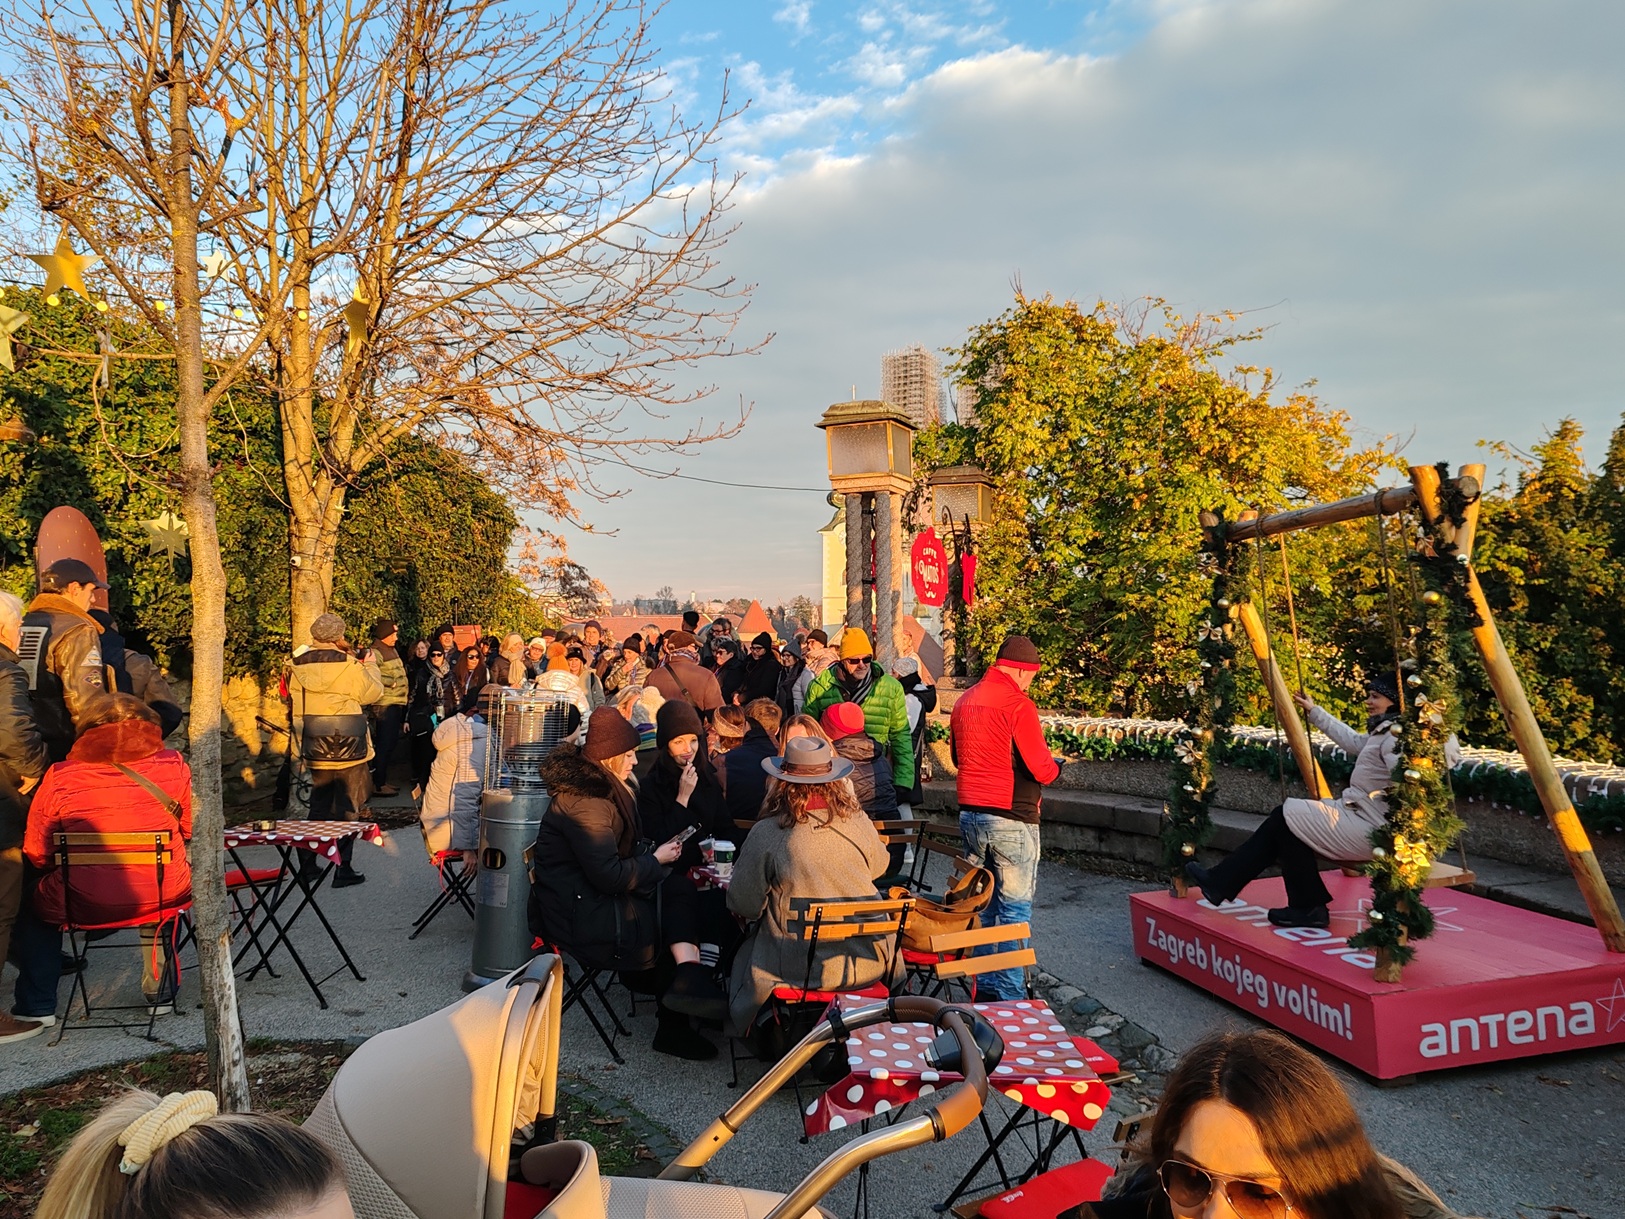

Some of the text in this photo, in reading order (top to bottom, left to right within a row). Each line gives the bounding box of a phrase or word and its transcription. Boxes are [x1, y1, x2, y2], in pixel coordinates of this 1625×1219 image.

[1145, 917, 1354, 1041] Zagreb kojeg volim!
